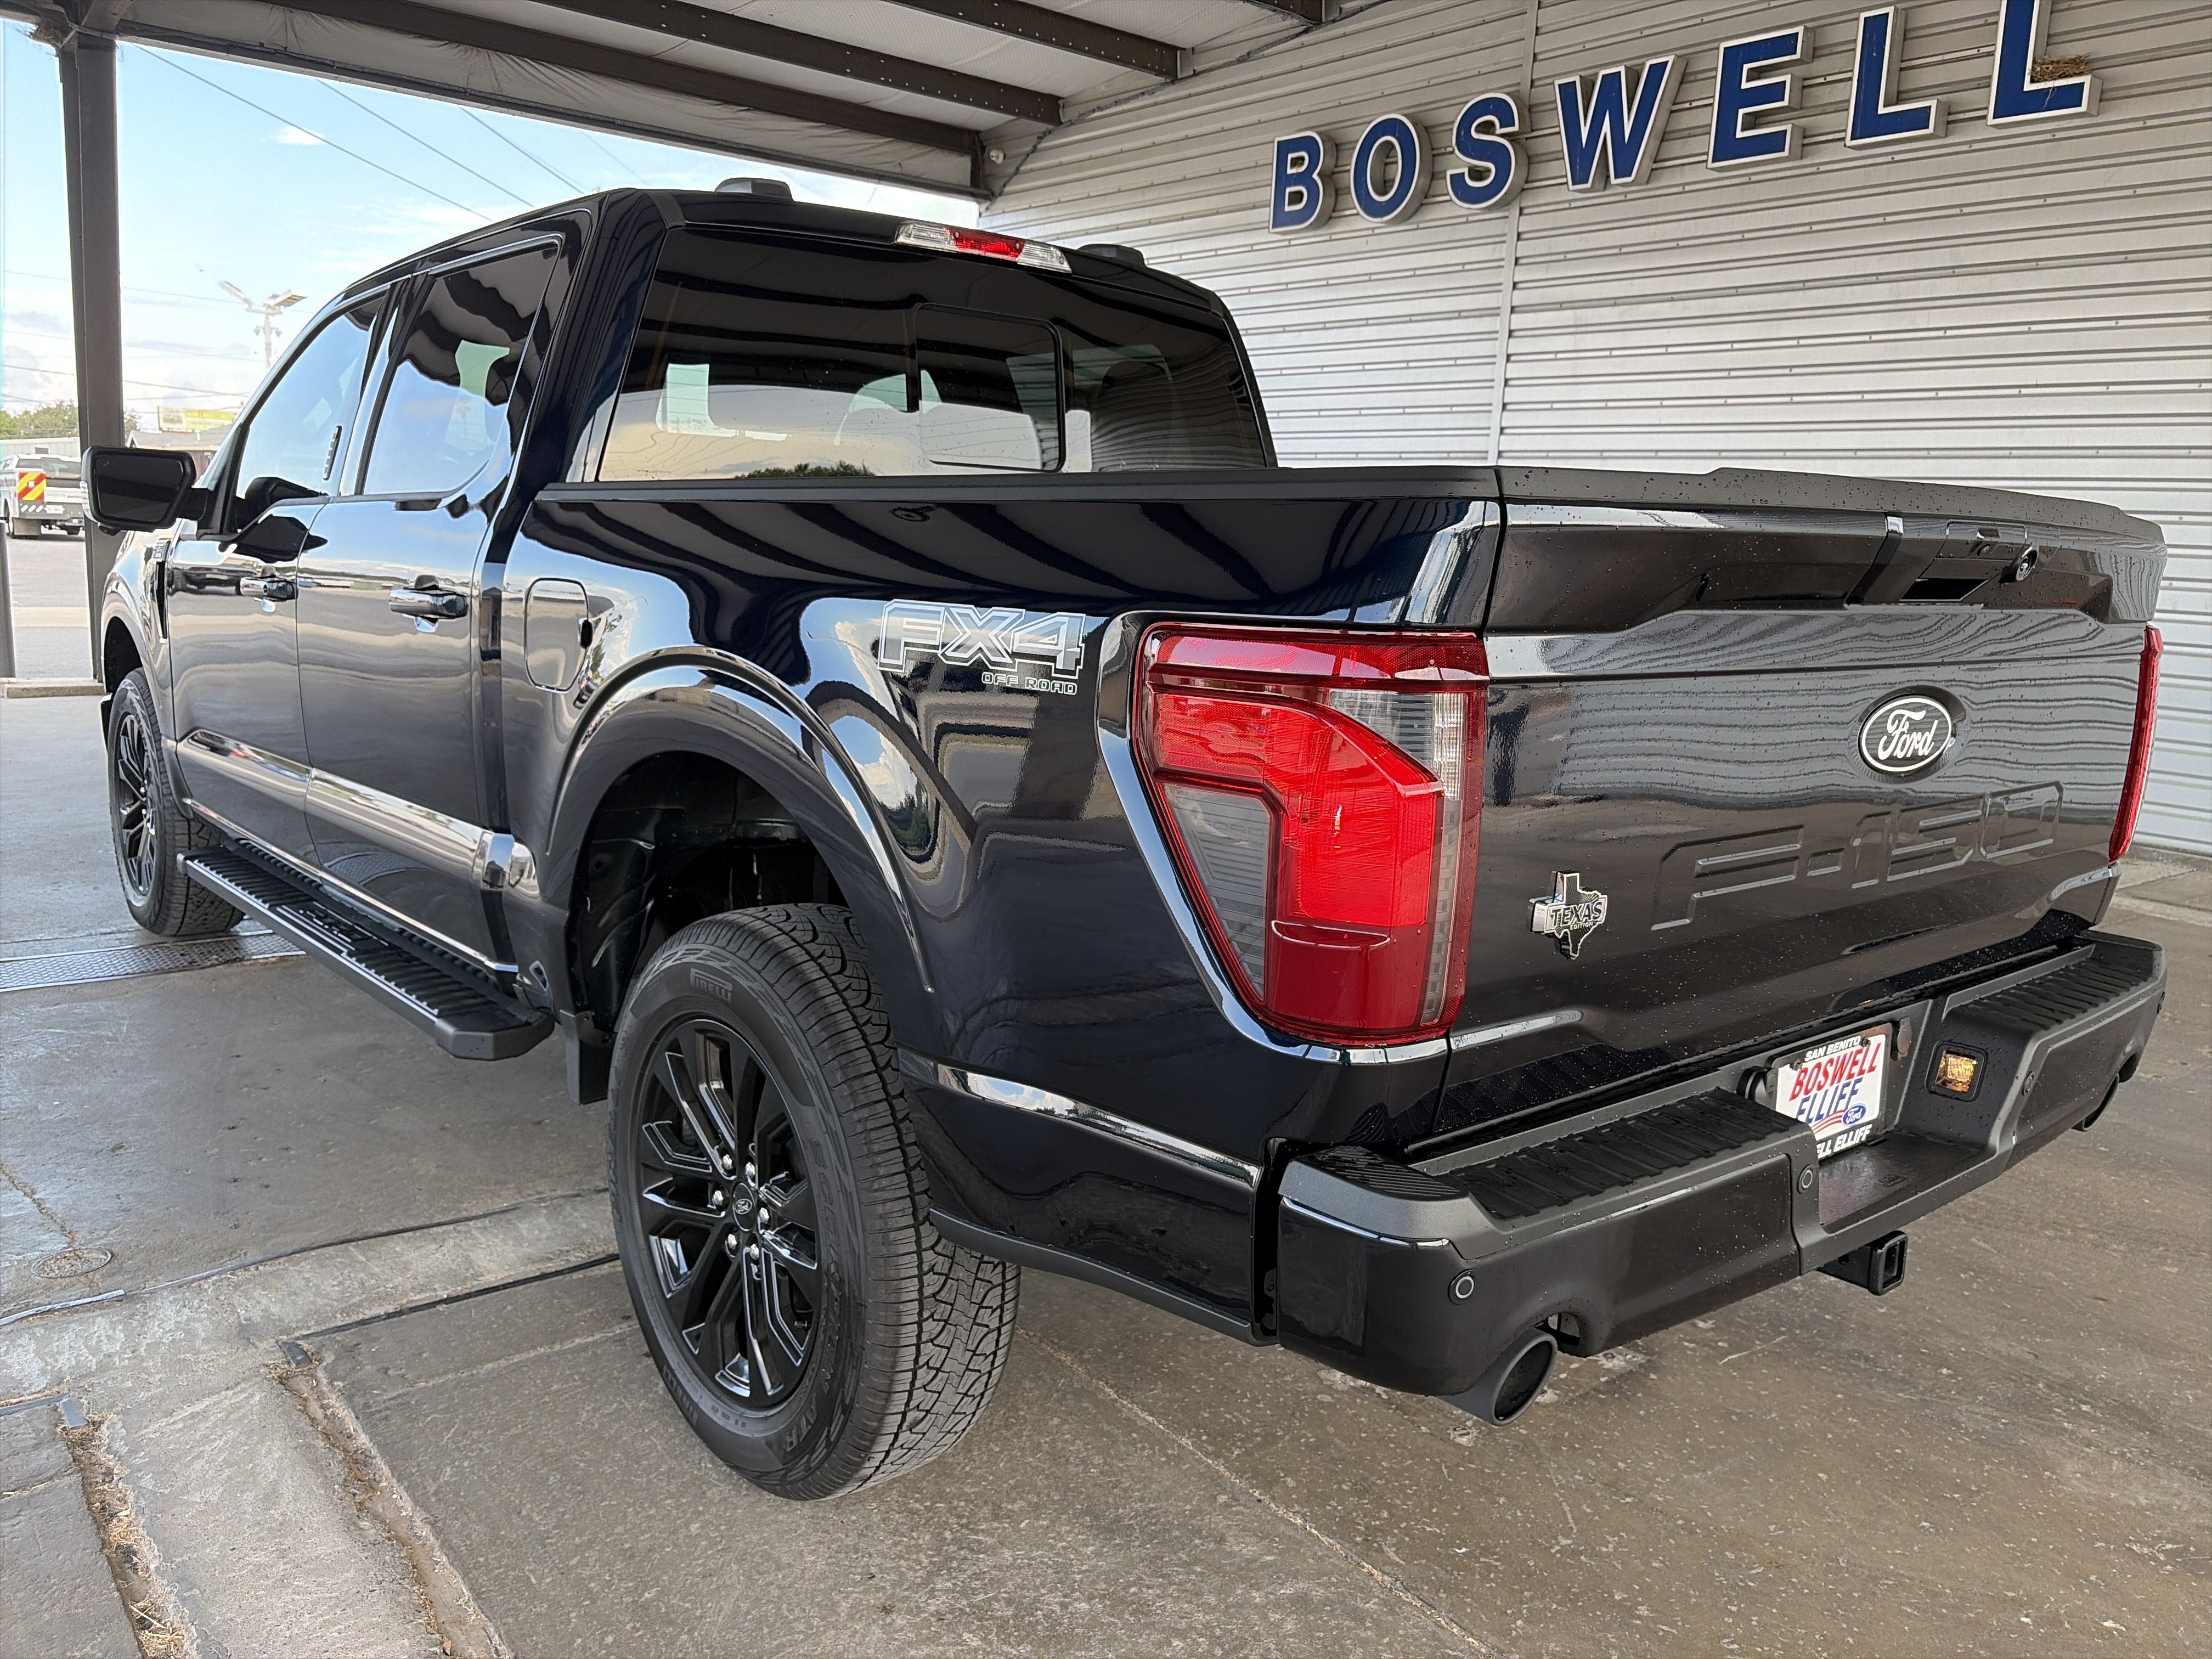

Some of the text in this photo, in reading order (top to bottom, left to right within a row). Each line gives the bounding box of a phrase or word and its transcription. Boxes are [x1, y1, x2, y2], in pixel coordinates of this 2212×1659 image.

[1268, 0, 2099, 234] BOSWELL
[877, 599, 1086, 679] FX4
[981, 672, 1077, 695] OFF ROAD
[1878, 709, 1938, 760] Ford
[1551, 902, 1603, 927] TEXAS
[1570, 922, 1594, 930] EDITION
[690, 968, 733, 1003] PIRELLI
[1804, 1035, 1861, 1062] SAN BENITO
[1789, 1043, 1881, 1101] BOSWELL
[1796, 1077, 1864, 1124] ELLIFF
[1846, 1107, 1863, 1124] Ford
[1833, 1124, 1872, 1153] ELLIFF
